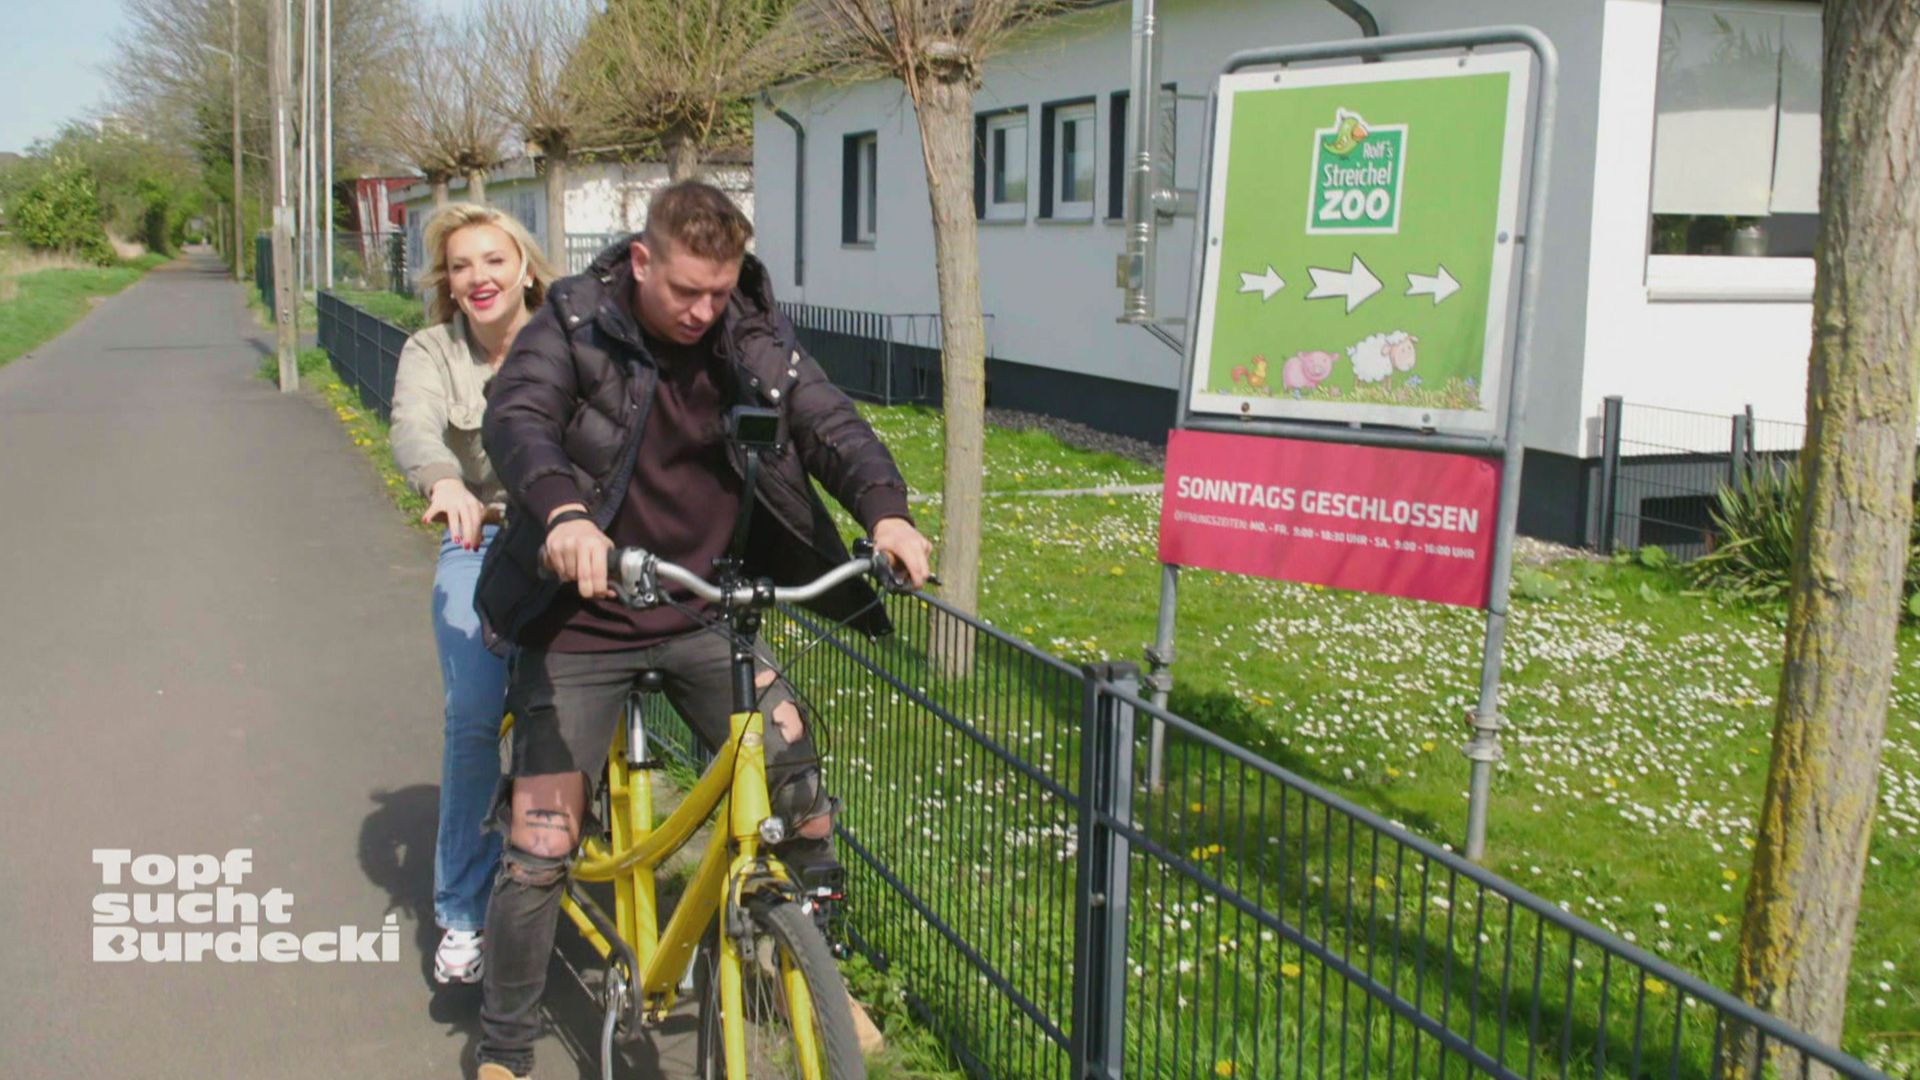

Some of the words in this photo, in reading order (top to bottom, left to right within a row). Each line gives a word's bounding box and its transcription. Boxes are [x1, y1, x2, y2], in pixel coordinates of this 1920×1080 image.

[1322, 160, 1392, 187] Streichel
[1319, 188, 1390, 220] ZOO
[1177, 475, 1296, 511] SONNTAGS
[1301, 490, 1479, 533] GESCHLOSSEN
[1346, 532, 1368, 546] UHR
[1452, 546, 1475, 560] UHR
